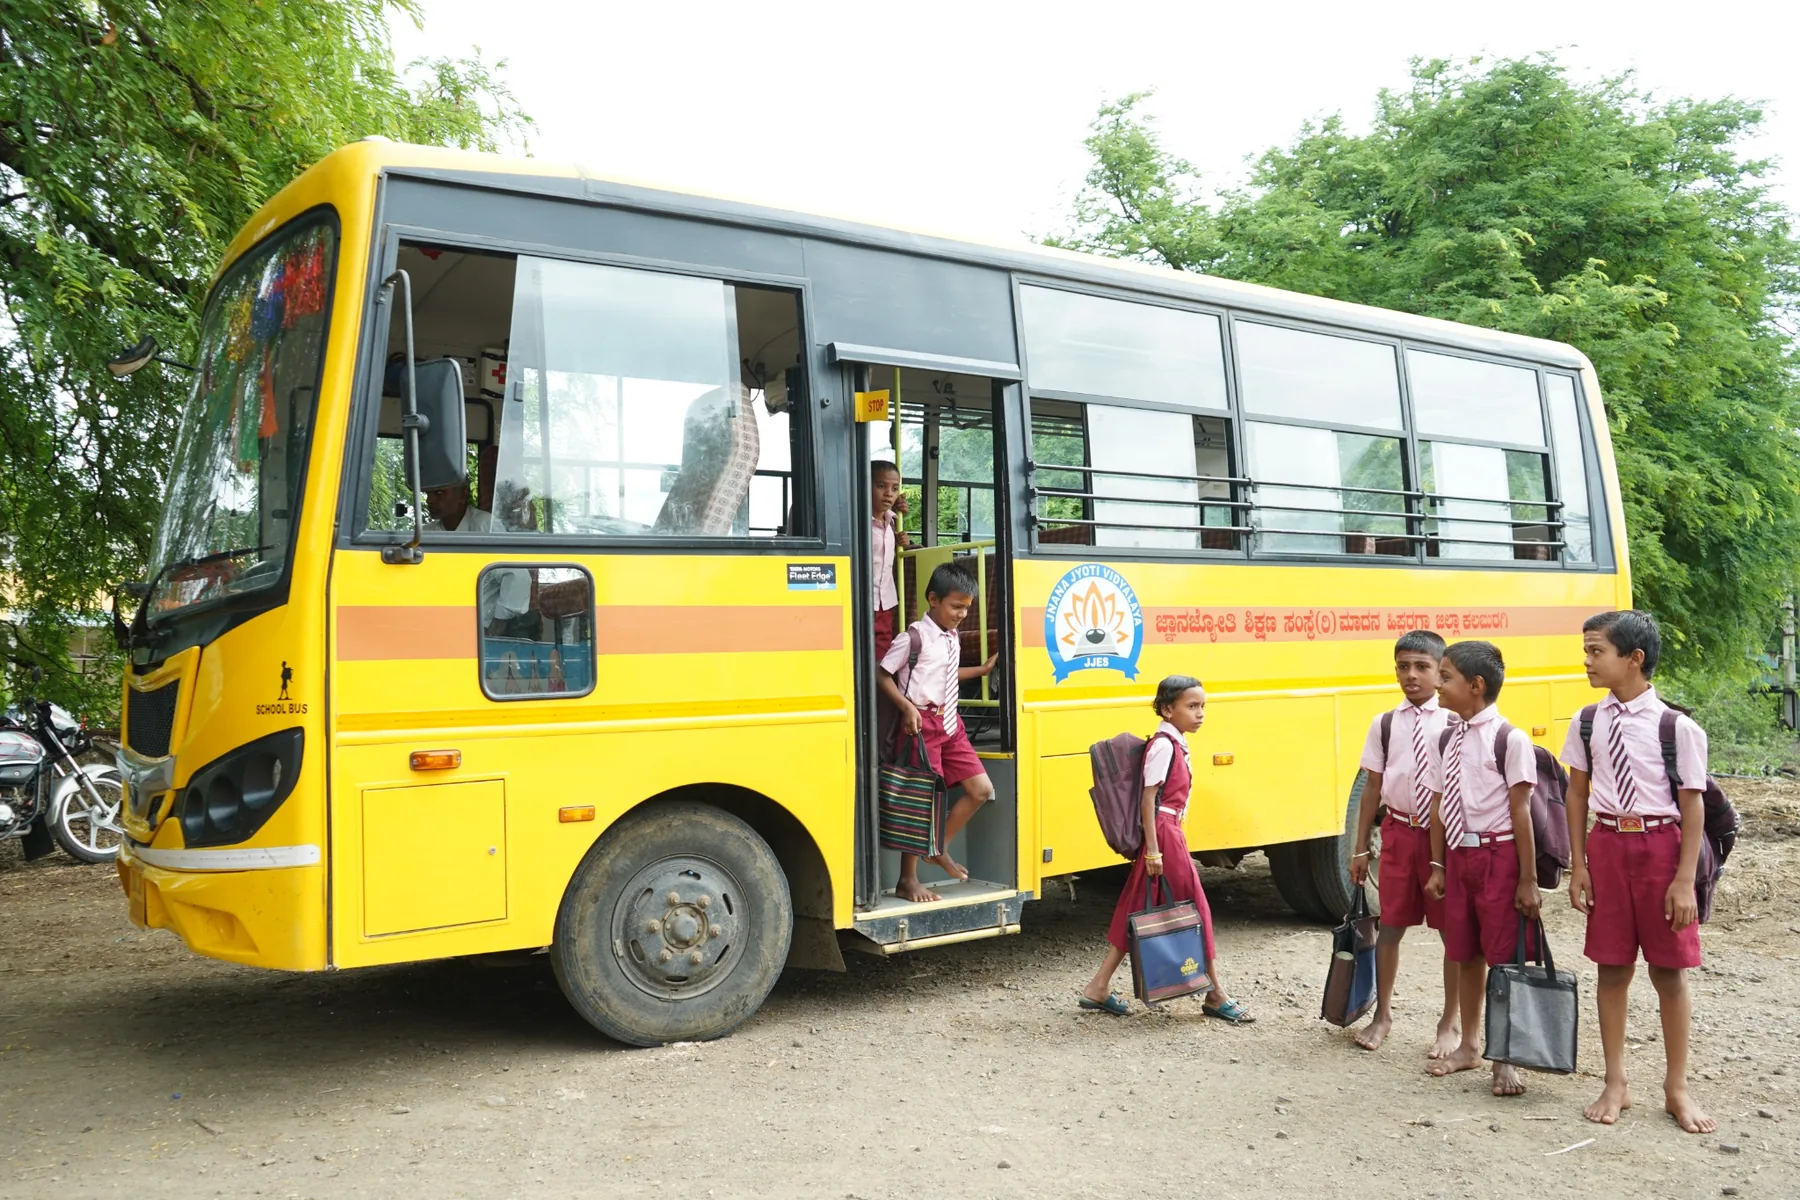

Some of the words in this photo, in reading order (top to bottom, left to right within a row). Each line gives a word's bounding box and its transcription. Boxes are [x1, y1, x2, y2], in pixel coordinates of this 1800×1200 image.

[868, 399, 884, 413] STOP
[789, 572, 810, 580] Fleet
[811, 572, 831, 582] Edge
[1046, 579, 1070, 623] JNANA
[1070, 565, 1100, 582] JYOTI
[1103, 567, 1142, 627] VIDYALAYA
[1156, 608, 1236, 643] ಜ್ಞಾನಜ್ಯೋತಿ
[1244, 610, 1277, 641] ಶಿಕ್ಷಣ
[1339, 611, 1380, 631] ಮಾದನ
[1463, 611, 1508, 630] ಕಲಬುರಗಿ
[1084, 657, 1109, 668] JJES
[256, 704, 287, 715] SCHOOL
[289, 703, 308, 714] BUS
